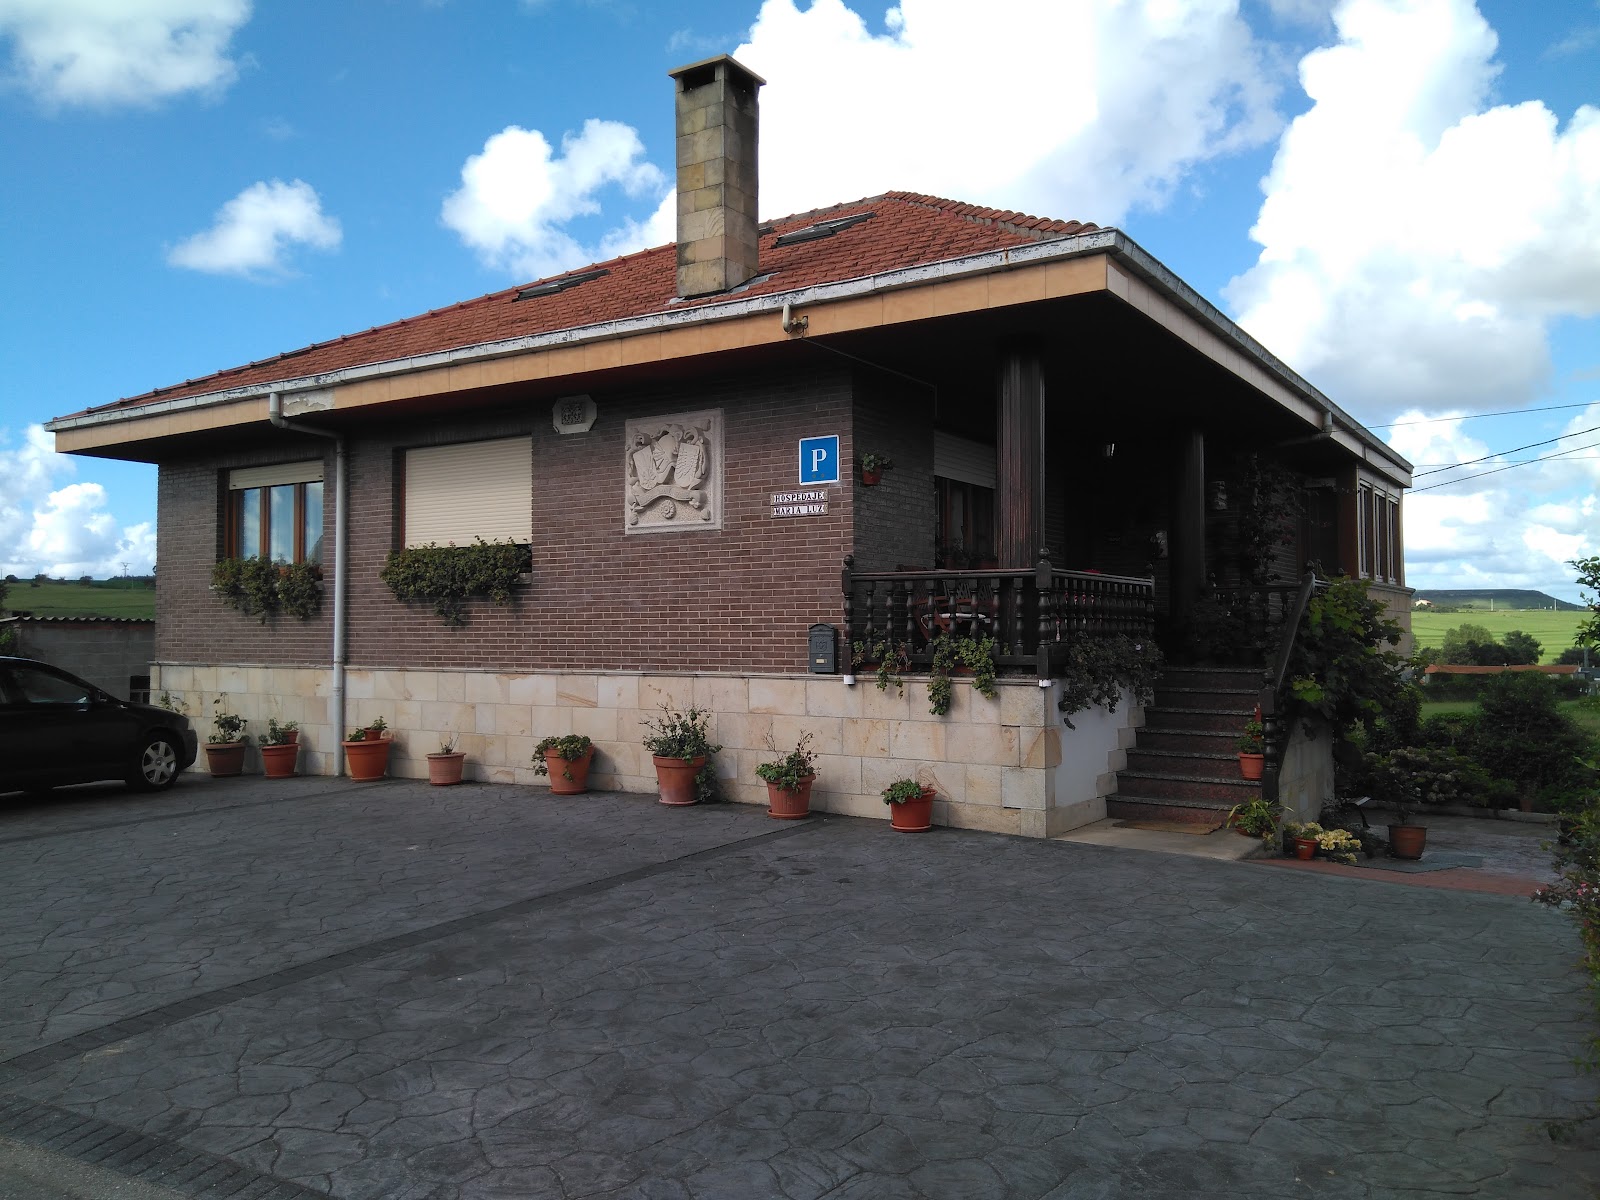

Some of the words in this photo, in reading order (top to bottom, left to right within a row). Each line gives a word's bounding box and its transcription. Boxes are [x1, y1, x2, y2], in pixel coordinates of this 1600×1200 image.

[811, 448, 827, 472] P
[775, 492, 823, 502] HOSPEDAJE
[775, 506, 801, 515] MARIA
[807, 505, 823, 513] LUZ
